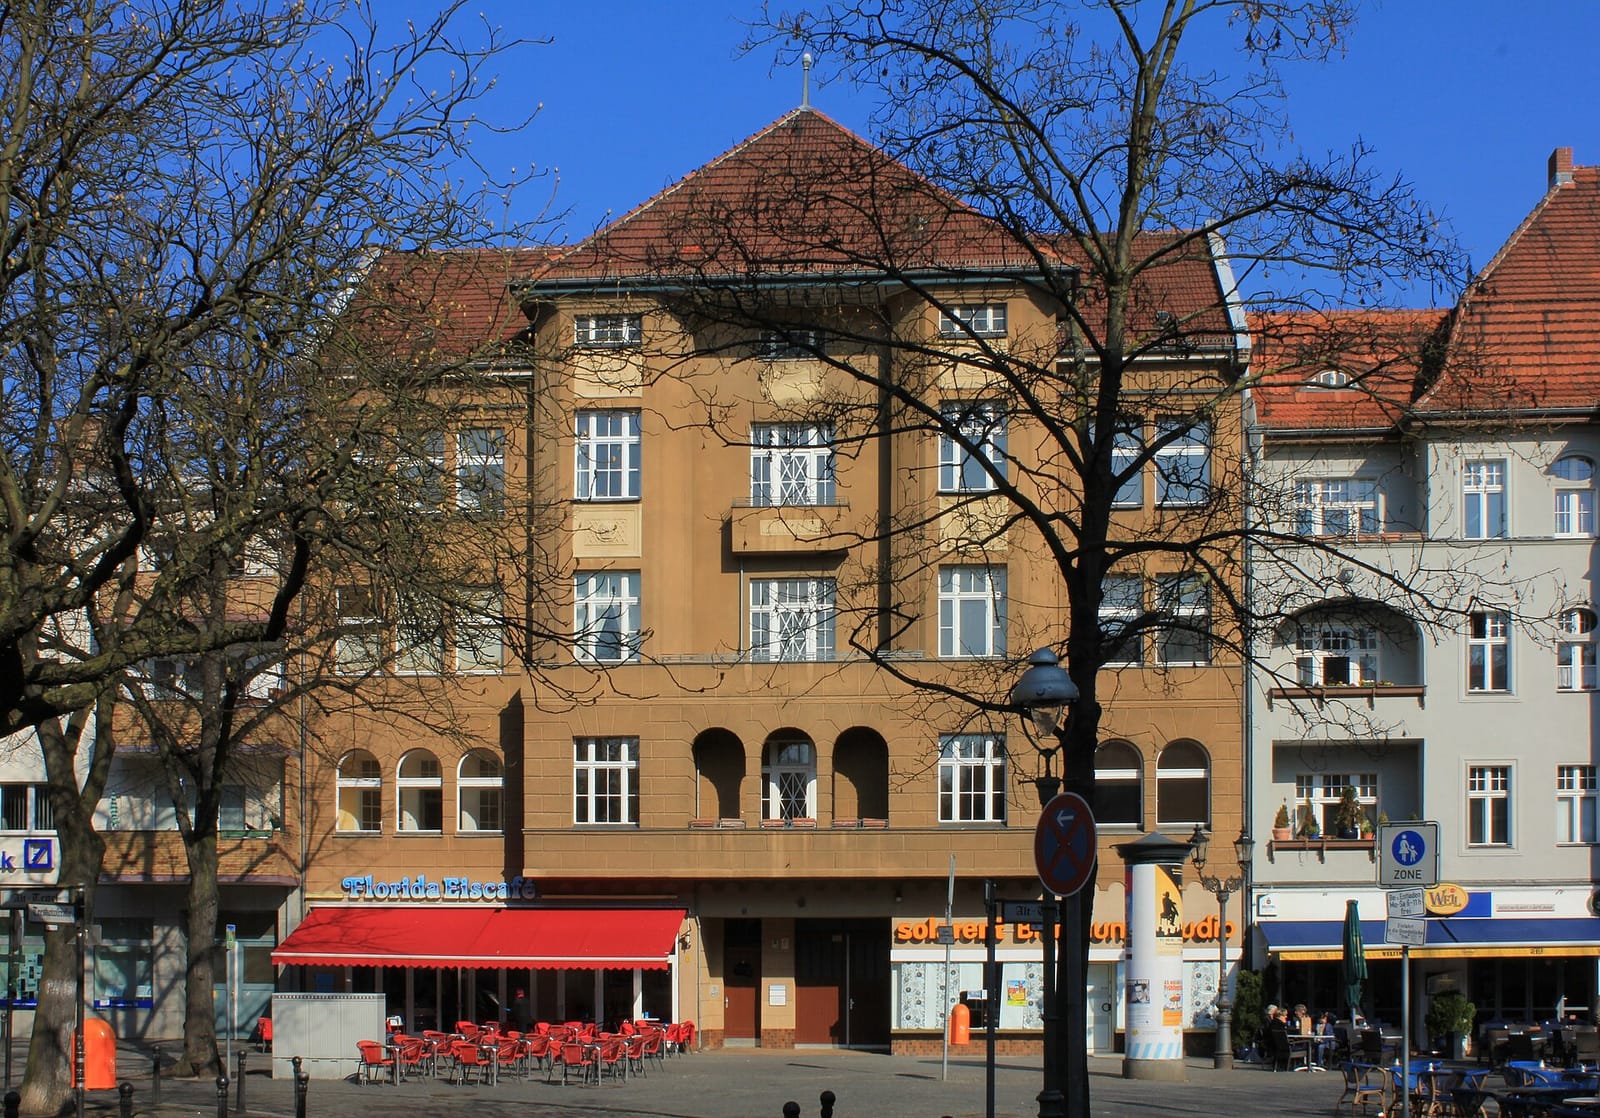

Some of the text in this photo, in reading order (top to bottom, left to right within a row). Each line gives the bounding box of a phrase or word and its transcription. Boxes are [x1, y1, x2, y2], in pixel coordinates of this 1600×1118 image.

[1393, 869, 1422, 880] ZONE
[342, 874, 536, 899] Florida Eiscafé
